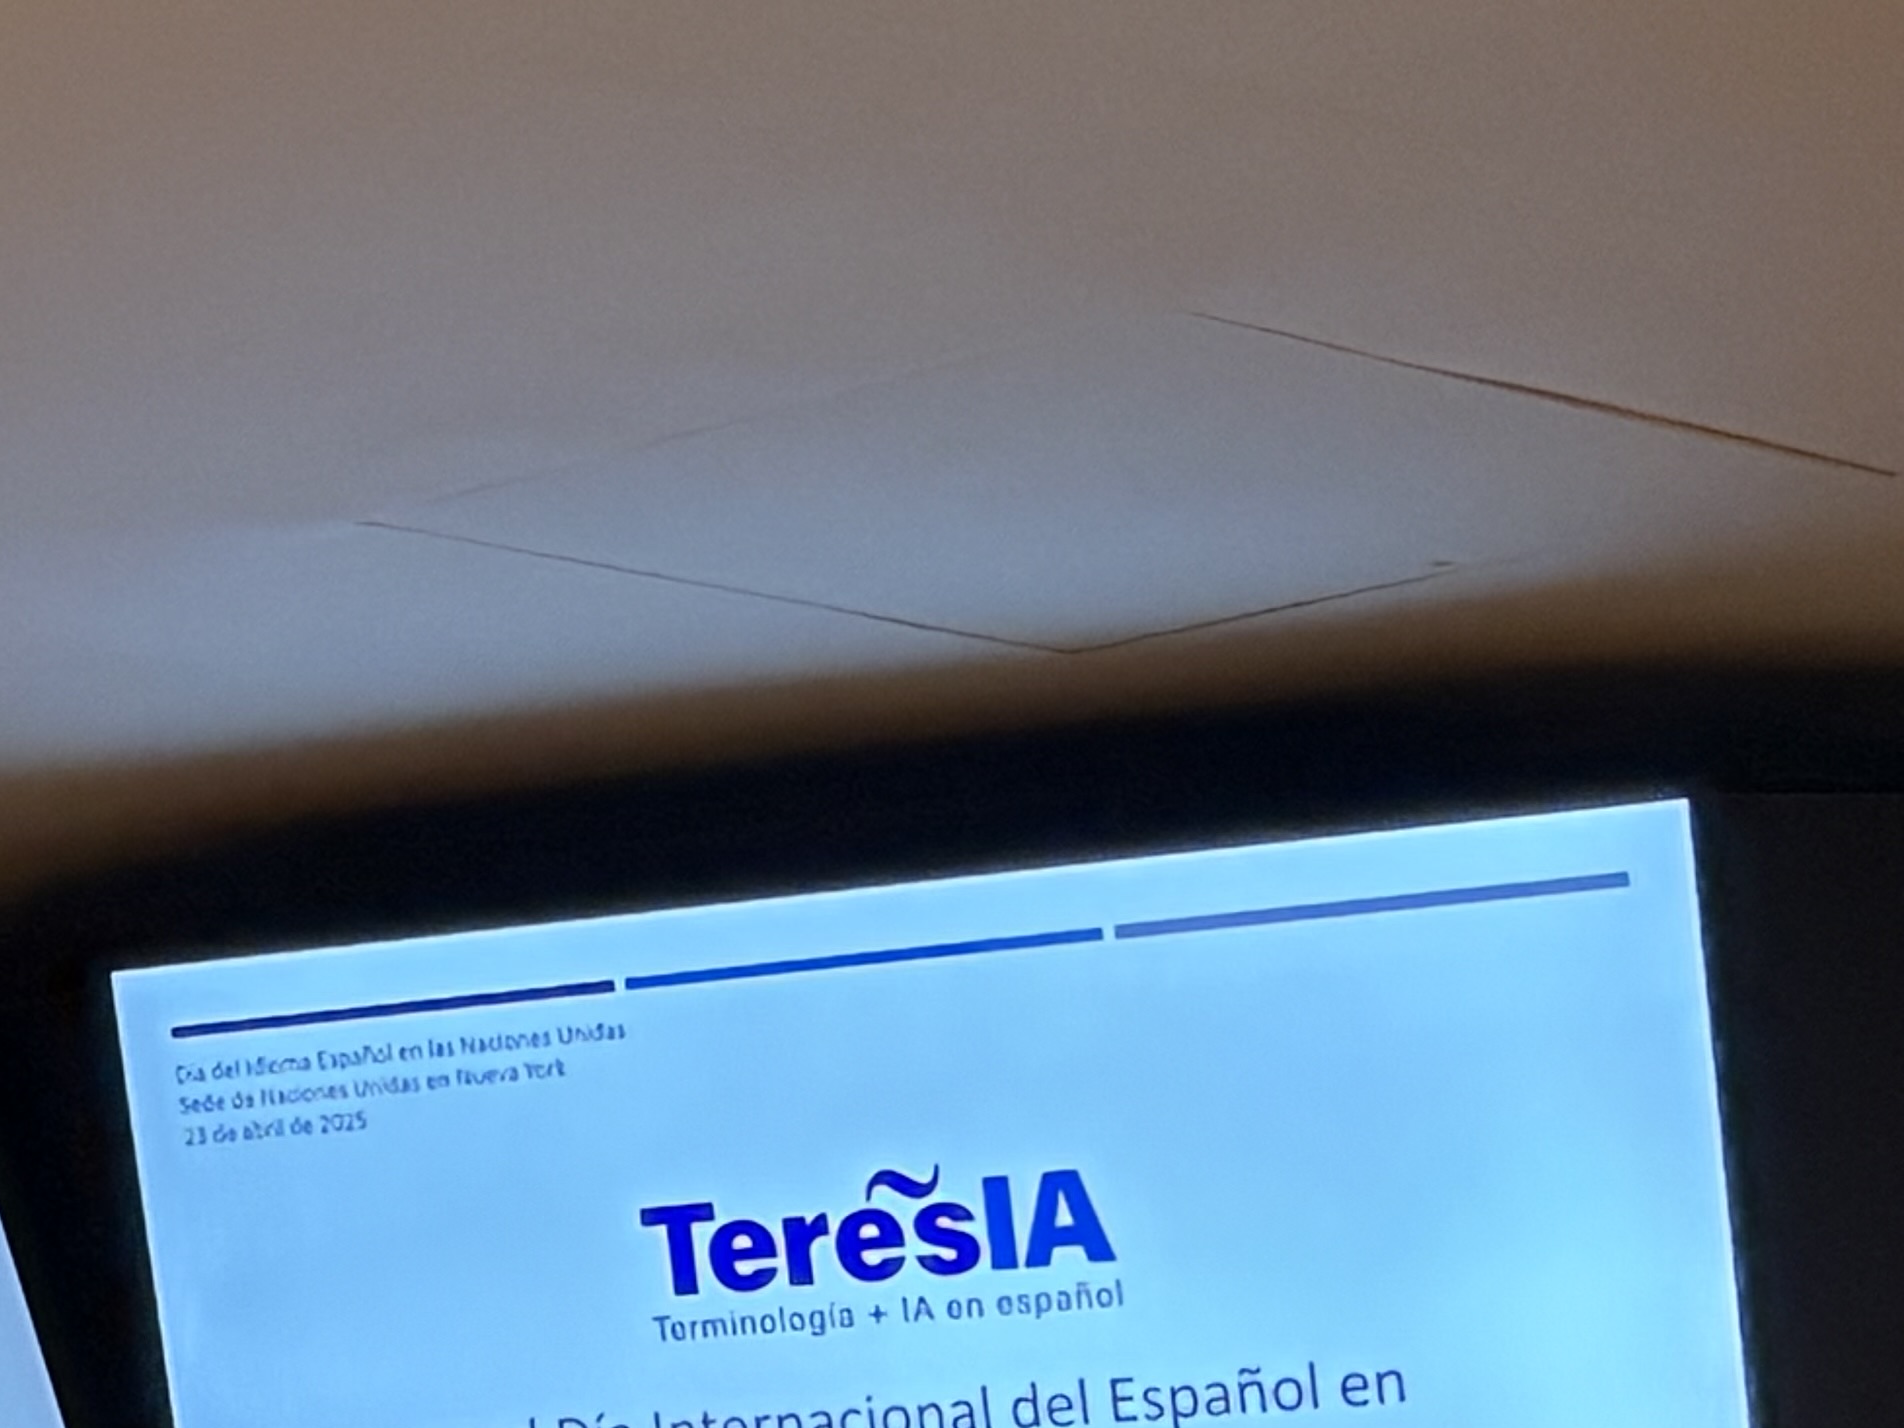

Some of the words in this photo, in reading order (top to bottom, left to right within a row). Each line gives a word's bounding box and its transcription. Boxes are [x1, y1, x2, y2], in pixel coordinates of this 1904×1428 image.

[212, 1060, 240, 1079] del
[318, 1043, 392, 1070] Español
[399, 1044, 423, 1061] en
[428, 1039, 454, 1058] las
[460, 1030, 551, 1054] Naciones
[557, 1023, 626, 1045] Unidas
[179, 1094, 225, 1115] Sede
[232, 1090, 254, 1109] de
[261, 1083, 348, 1107] Naciones
[353, 1076, 420, 1099] Unidas
[427, 1074, 450, 1090] en
[456, 1066, 519, 1086] Nueva
[524, 1058, 566, 1079] York
[185, 1126, 207, 1146] 23
[213, 1124, 237, 1143] de
[244, 1119, 284, 1140] abril
[291, 1117, 313, 1135] de
[320, 1111, 367, 1134] 2025
[653, 1301, 855, 1343] Terminología
[868, 1304, 889, 1324] +
[902, 1295, 935, 1323] IA
[947, 1295, 984, 1321] en
[996, 1279, 1124, 1319] español
[1012, 1379, 1090, 1428] del
[1340, 1368, 1406, 1406] en
